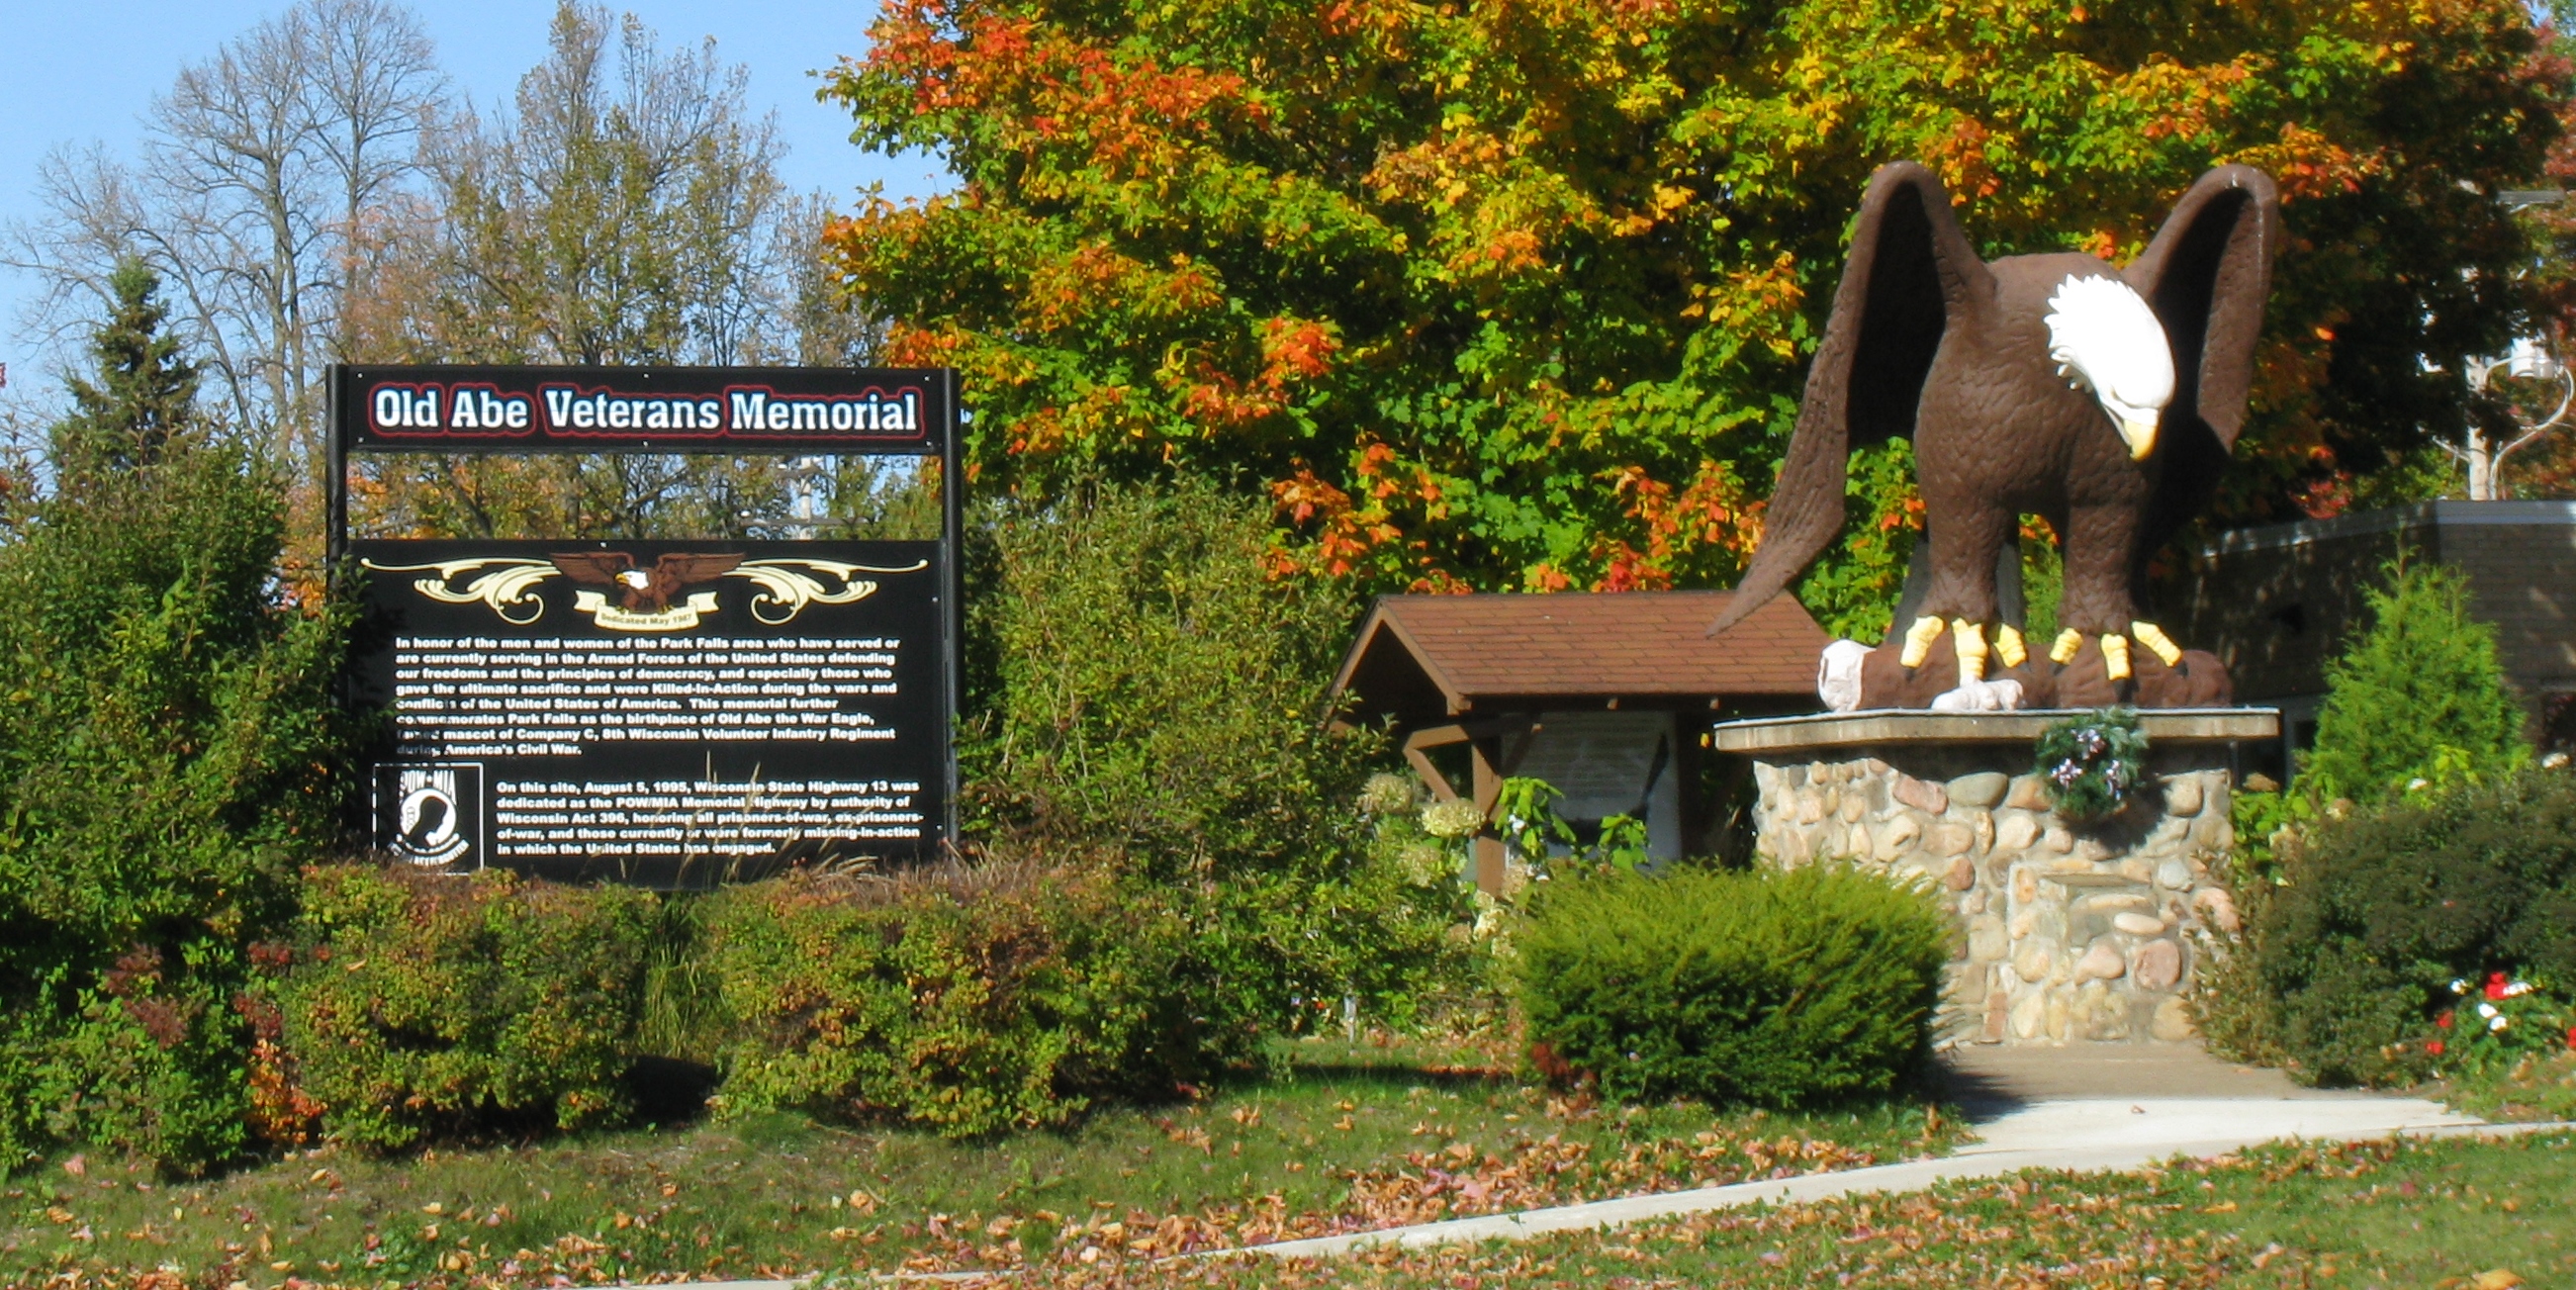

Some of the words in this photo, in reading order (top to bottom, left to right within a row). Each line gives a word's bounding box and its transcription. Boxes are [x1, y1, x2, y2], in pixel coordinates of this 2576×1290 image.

[376, 390, 438, 426] Old
[451, 392, 527, 427] Abe
[546, 391, 719, 428] Veterans
[731, 394, 917, 429] Memorial
[600, 613, 648, 625] Dedicated
[649, 614, 671, 627] May
[396, 638, 411, 648] In
[414, 638, 454, 648] honor
[457, 637, 472, 648] of
[474, 638, 498, 648] the
[501, 639, 531, 648] men
[534, 638, 560, 648] and
[563, 639, 614, 648] women
[616, 638, 632, 649] of
[634, 638, 658, 648] the
[661, 638, 693, 648] Park
[696, 638, 730, 648] Falls
[732, 639, 764, 648] area
[767, 638, 796, 648] who
[799, 638, 832, 648] have
[835, 638, 882, 648] served
[884, 639, 900, 648] or
[396, 654, 419, 663] are
[422, 653, 487, 665] currently
[490, 653, 542, 665] serving
[545, 653, 559, 664] in
[561, 653, 585, 664] the
[588, 653, 634, 664] Armed
[637, 653, 685, 664] Forces
[688, 653, 702, 664] of
[704, 653, 728, 664] the
[731, 653, 778, 664] United
[781, 653, 825, 663] States
[828, 653, 895, 665] defending
[396, 670, 420, 679] our
[422, 668, 489, 679] freedoms
[491, 669, 517, 679] and
[520, 668, 544, 679] the
[547, 669, 615, 681] principles
[618, 669, 633, 679] of
[636, 669, 715, 681] democracy,
[718, 668, 745, 679] and
[748, 668, 818, 681] especially
[821, 668, 860, 678] those
[863, 668, 892, 678] who
[396, 686, 429, 695] gave
[432, 684, 456, 693] the
[459, 683, 517, 693] ultimate
[520, 684, 581, 693] sacrifice
[584, 684, 611, 693] and
[613, 685, 649, 693] were
[652, 683, 759, 693] Killed-In-Action
[761, 683, 805, 695] during
[807, 683, 831, 693] the
[834, 684, 869, 693] wars
[872, 683, 897, 692] and
[396, 698, 457, 710] conflicts
[460, 698, 476, 708] of
[478, 698, 502, 709] the
[505, 698, 551, 709] United
[554, 698, 599, 708] States
[602, 698, 617, 708] of
[619, 698, 682, 709] America.
[689, 698, 720, 708] This
[722, 698, 787, 708] memorial
[789, 698, 839, 708] further
[396, 714, 505, 724] commemorates
[507, 713, 540, 724] Park
[543, 713, 577, 724] Falls
[580, 715, 598, 724] as
[599, 713, 623, 724] the
[626, 713, 697, 725] birthplace
[700, 713, 715, 724] of
[717, 713, 742, 724] Old
[744, 713, 772, 723] Abe
[775, 713, 798, 723] the
[800, 713, 828, 723] War
[831, 713, 874, 725] Eagle,
[443, 729, 496, 739] mascot
[499, 728, 513, 739] of
[516, 729, 581, 741] Company
[584, 729, 599, 741] C,
[602, 729, 625, 739] 8th
[628, 729, 699, 739] Wisconsin
[701, 728, 770, 739] Volunteer
[773, 728, 827, 741] Infantry
[830, 728, 896, 741] Regiment
[443, 744, 514, 755] America's
[516, 744, 548, 754] Civil
[550, 744, 582, 754] War.
[497, 783, 516, 792] On
[519, 783, 547, 792] this
[550, 783, 581, 793] site,
[584, 783, 633, 793] August
[636, 782, 650, 793] 5,
[653, 782, 691, 793] 1995,
[693, 782, 766, 793] Wisconsin
[768, 782, 805, 793] State
[808, 782, 869, 793] Highway
[872, 781, 888, 791] 13
[890, 782, 920, 790] was
[497, 797, 567, 808] dedicated
[569, 799, 587, 808] as
[590, 797, 613, 808] the
[616, 797, 679, 809] POW/MIA
[682, 795, 746, 809] Memorial
[811, 796, 828, 809] by
[831, 795, 893, 809] authority
[895, 796, 910, 806] of
[496, 813, 569, 823] Wisconsin
[572, 813, 596, 823] Act
[599, 812, 629, 824] 396,
[632, 811, 693, 825] honoring
[696, 811, 714, 822] all
[717, 811, 832, 825] prisoners-of-war,
[835, 811, 924, 825] ex-prisoners-
[497, 828, 545, 840] of-war,
[548, 828, 574, 839] and
[577, 828, 616, 839] those
[619, 826, 684, 840] currently
[687, 827, 701, 839] or
[703, 826, 739, 838] were
[742, 827, 801, 841] formerly
[804, 827, 920, 840] missing-in-action
[497, 844, 511, 854] in
[513, 844, 557, 854] which
[560, 844, 583, 854] the
[586, 843, 632, 854] United
[635, 843, 682, 854] States
[684, 842, 709, 855] has
[712, 844, 777, 857] engaged.
